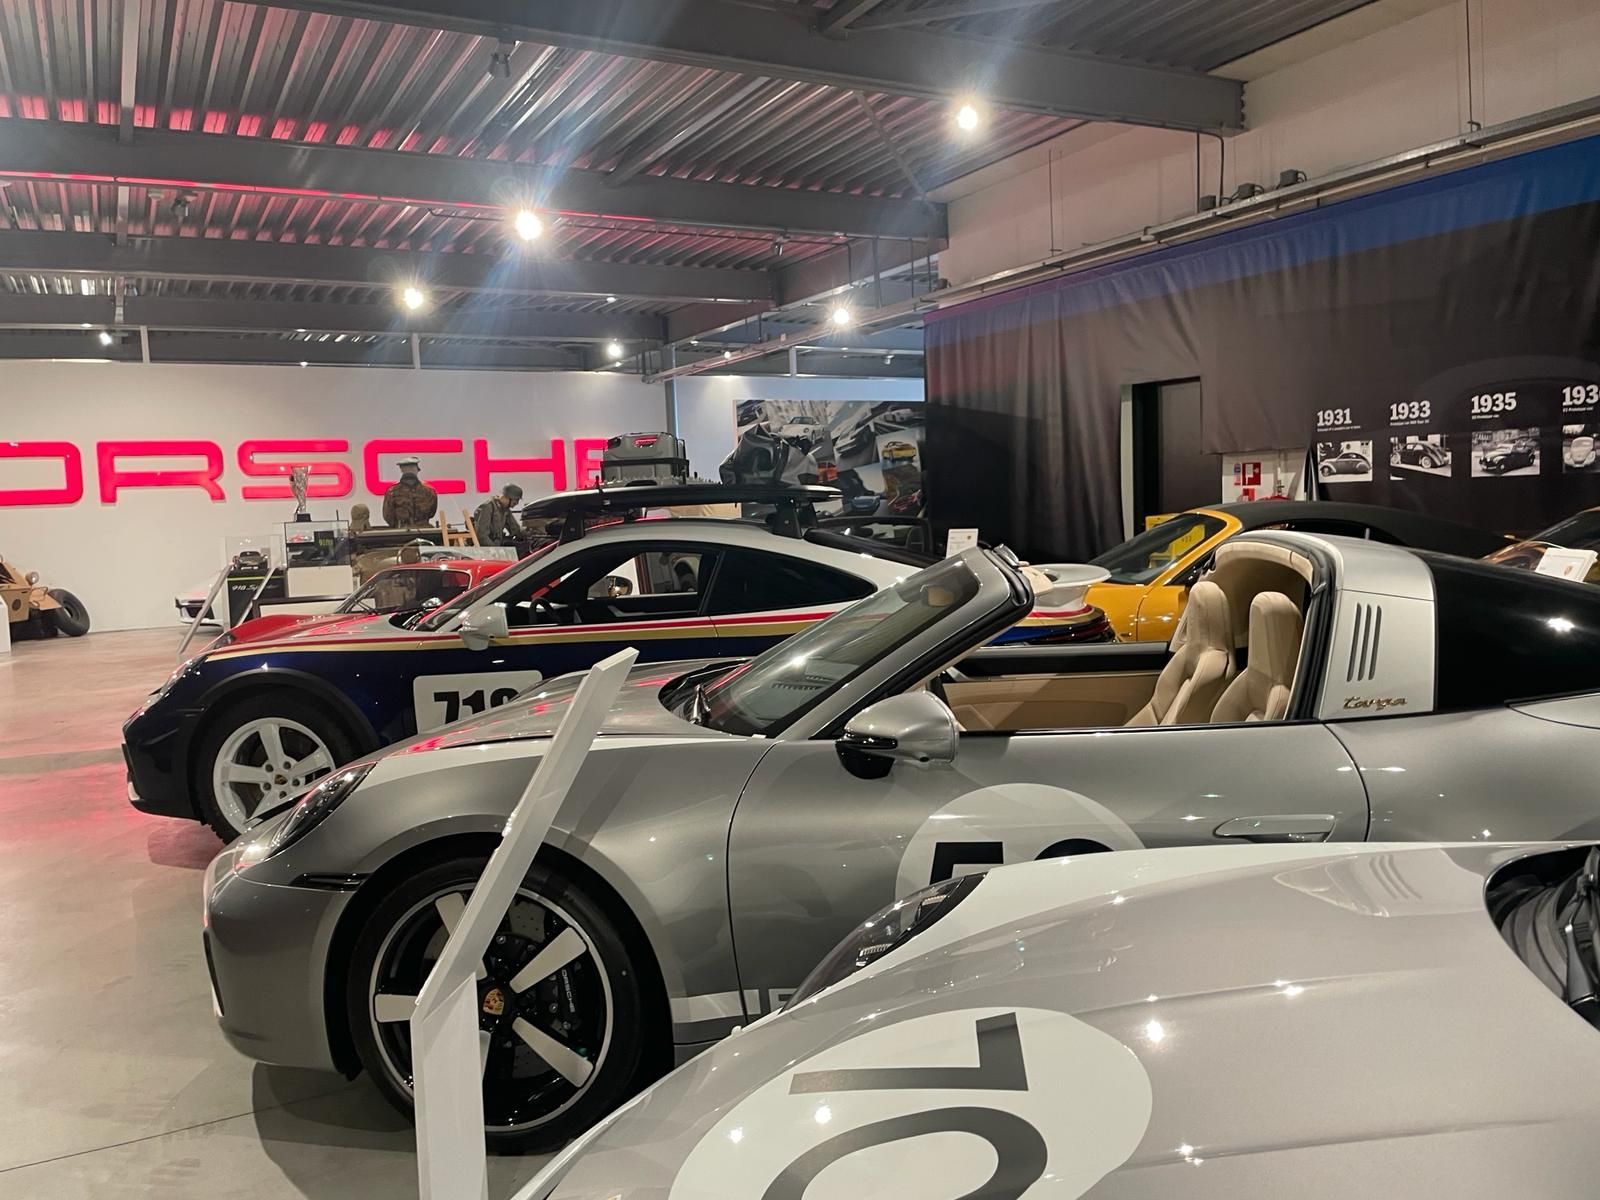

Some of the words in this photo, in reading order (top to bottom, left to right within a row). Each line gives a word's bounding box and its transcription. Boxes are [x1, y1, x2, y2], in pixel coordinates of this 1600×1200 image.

[1471, 392, 1517, 414] 1935
[1562, 384, 1600, 406] 193
[1316, 408, 1352, 427] 1931
[1389, 400, 1431, 420] 1933
